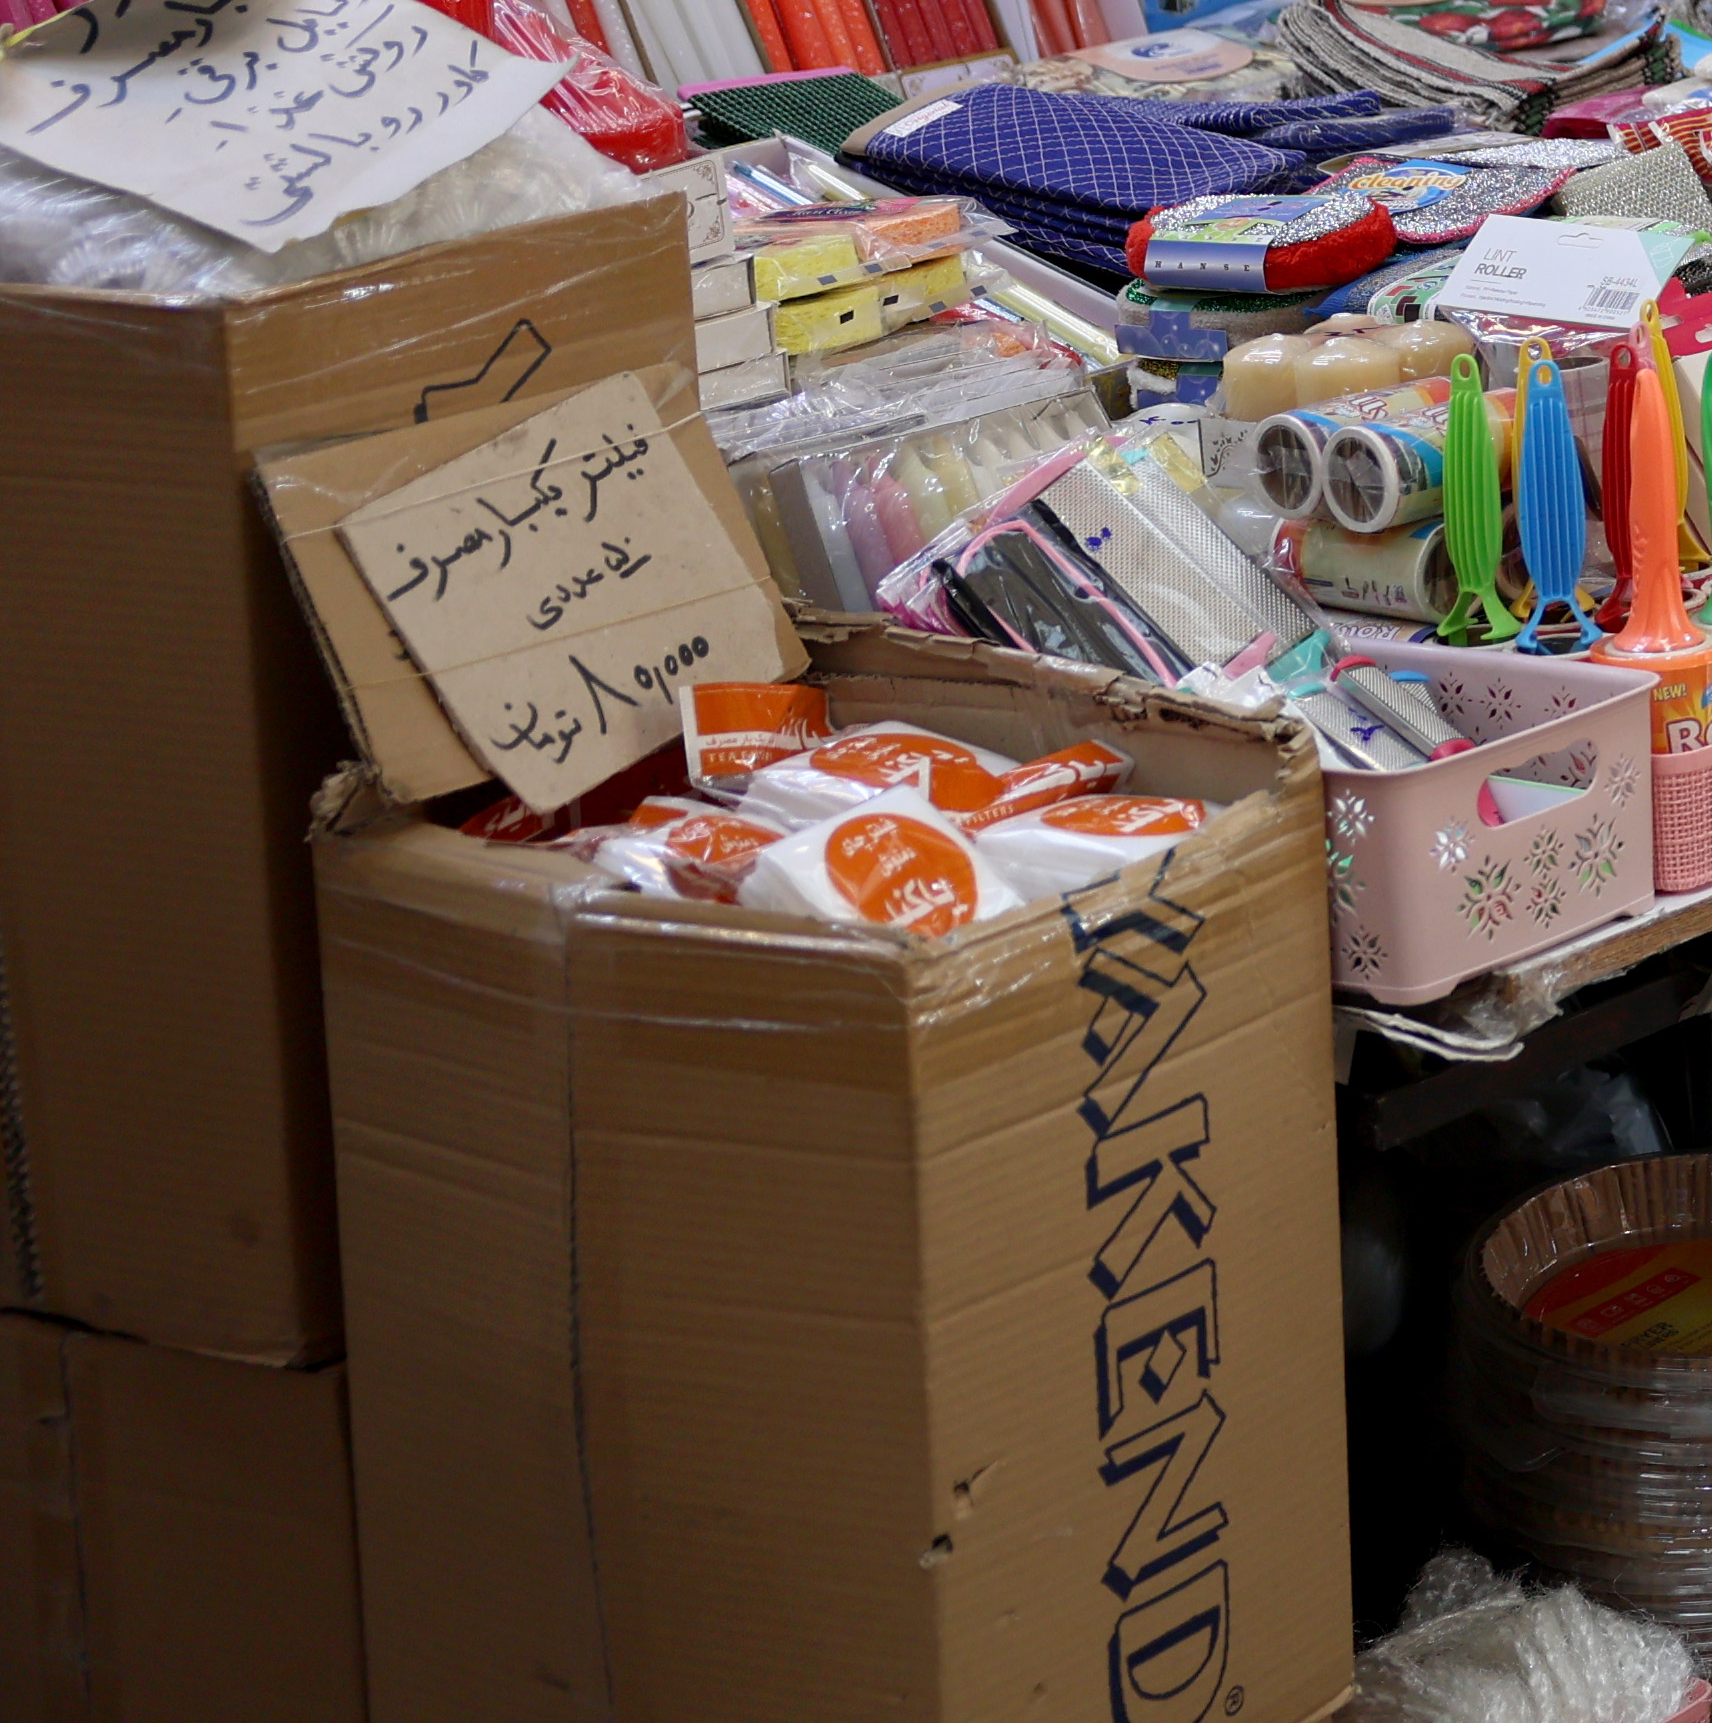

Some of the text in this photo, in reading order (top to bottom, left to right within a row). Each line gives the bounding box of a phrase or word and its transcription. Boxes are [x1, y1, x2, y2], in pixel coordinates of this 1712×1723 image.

[1483, 247, 1518, 263] LINT
[1473, 262, 1528, 280] ROLLER
[1653, 684, 1688, 702] NEW!
[708, 751, 738, 764] TEA
[1060, 847, 1230, 1723] YAKEND
